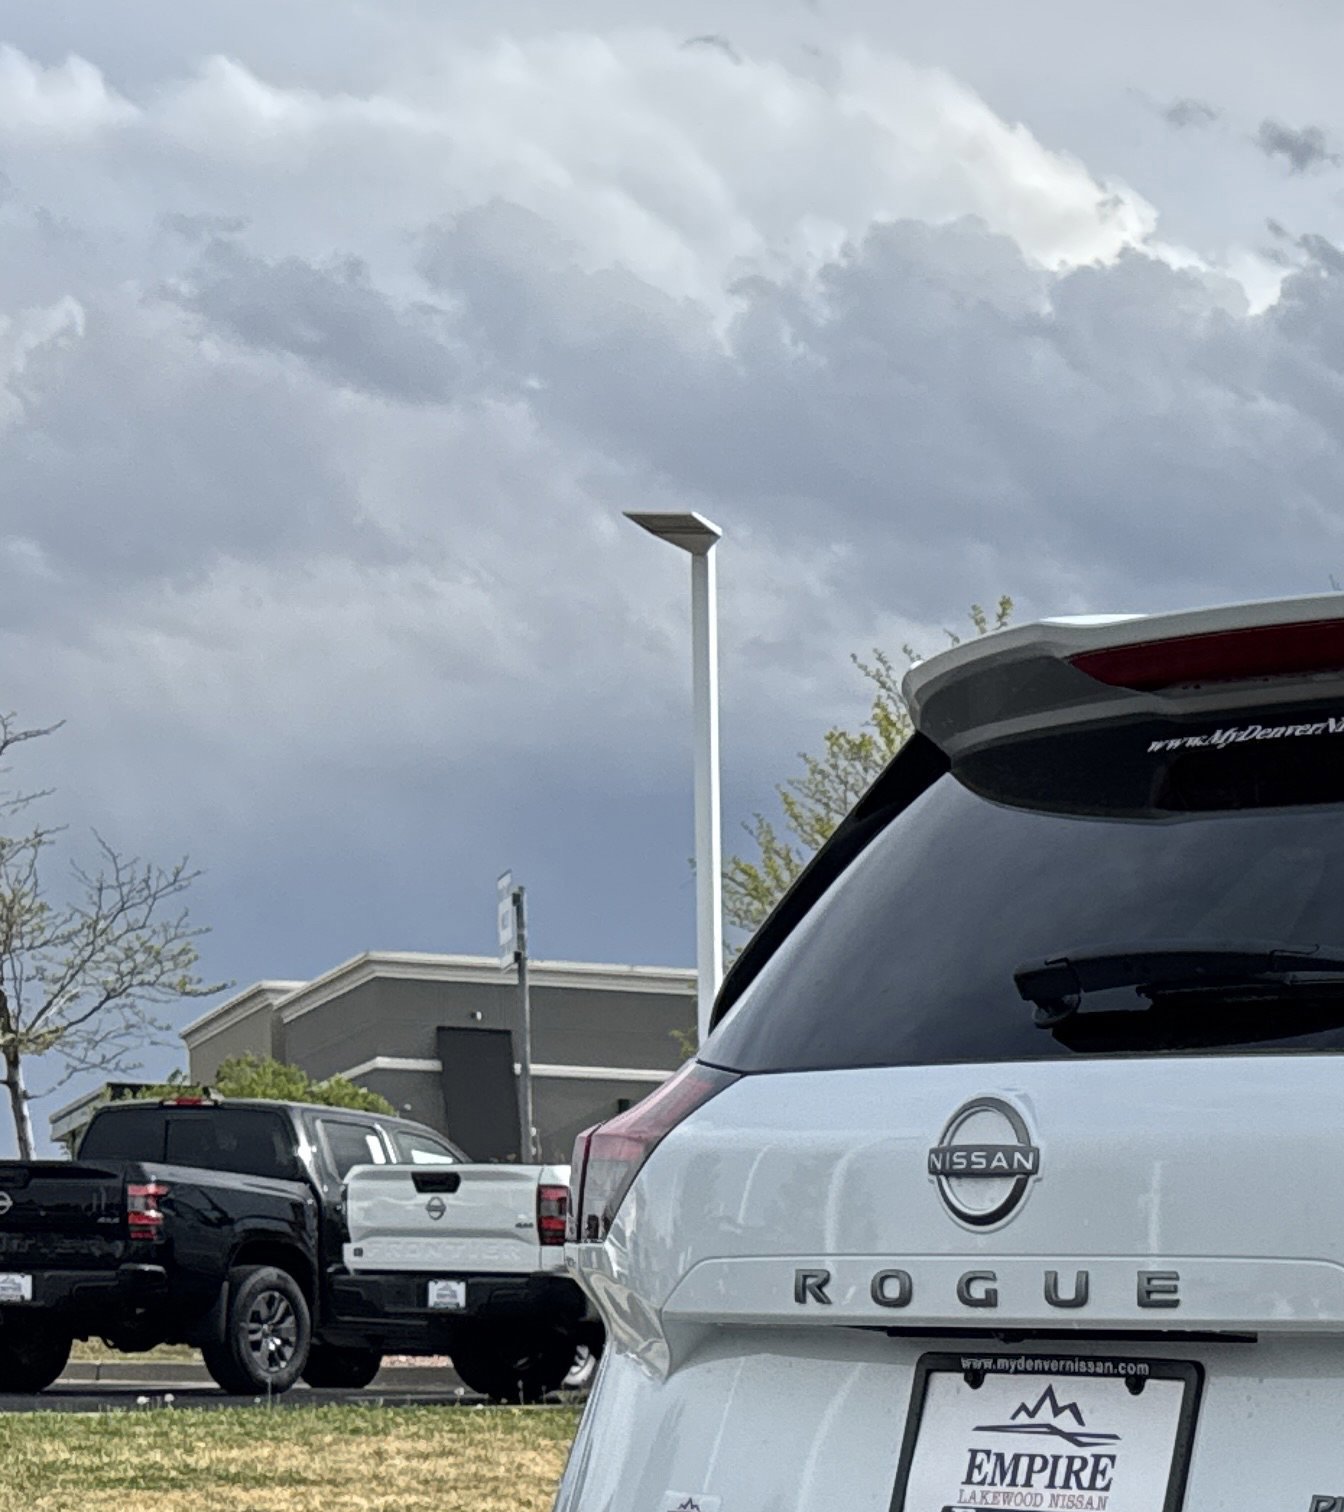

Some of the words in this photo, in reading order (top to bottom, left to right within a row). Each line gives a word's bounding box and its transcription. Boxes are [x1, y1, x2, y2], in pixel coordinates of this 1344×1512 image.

[930, 1151, 1034, 1171] NISSAN
[794, 1268, 1181, 1309] ROGUE
[961, 1356, 1150, 1376] www.mydenvernissan.com
[961, 1449, 1117, 1492] EMPIRE
[957, 1489, 1044, 1509] LAKEWOOD
[1049, 1493, 1109, 1512] NISSAN
